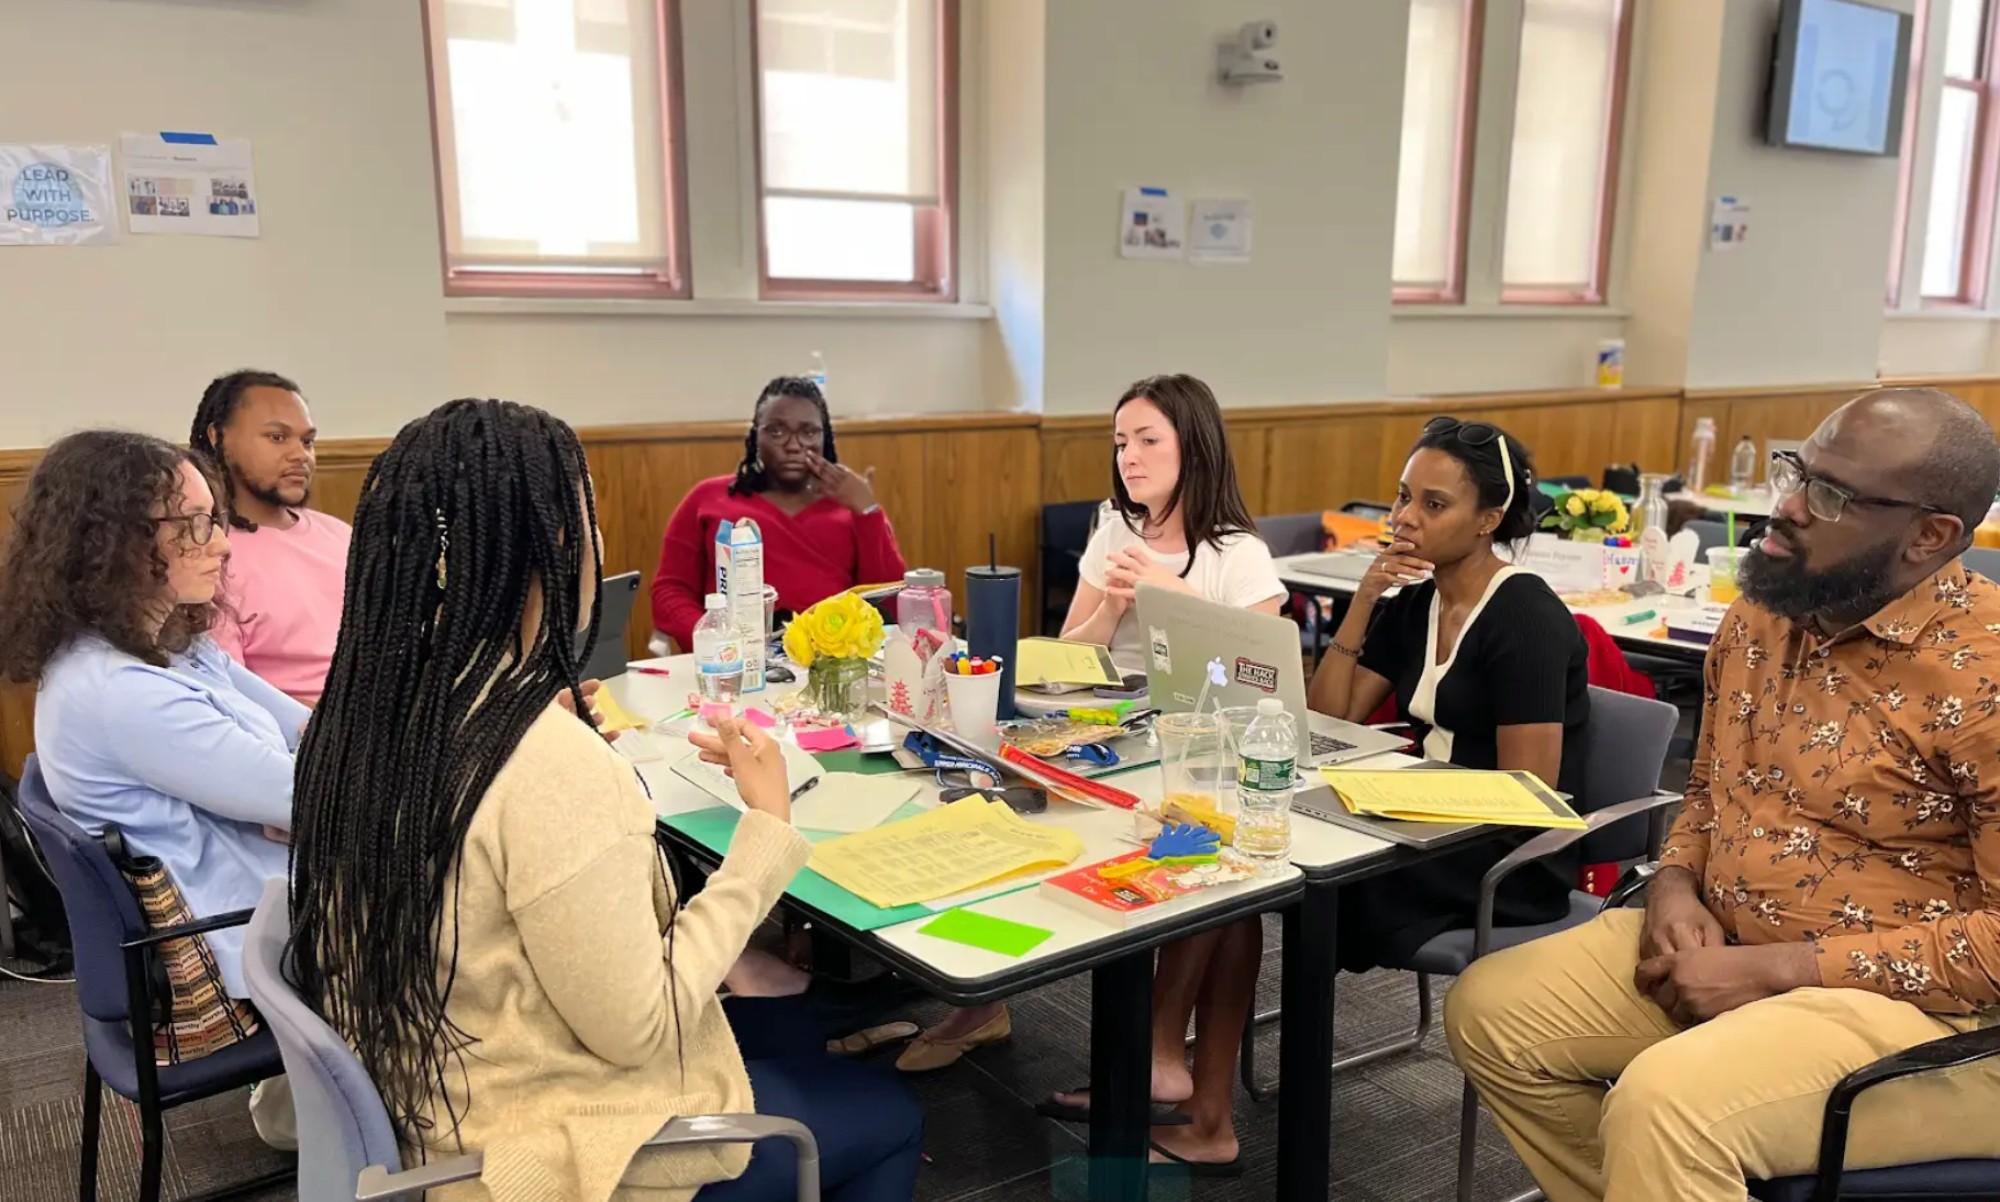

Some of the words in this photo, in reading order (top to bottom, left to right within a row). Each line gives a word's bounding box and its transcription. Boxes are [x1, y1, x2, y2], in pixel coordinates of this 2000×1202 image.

[22, 168, 69, 183] LEAD
[23, 187, 72, 203] WITH
[7, 207, 95, 223] PURPOSE.
[175, 1023, 200, 1031] worthy
[202, 1009, 225, 1024] worthy
